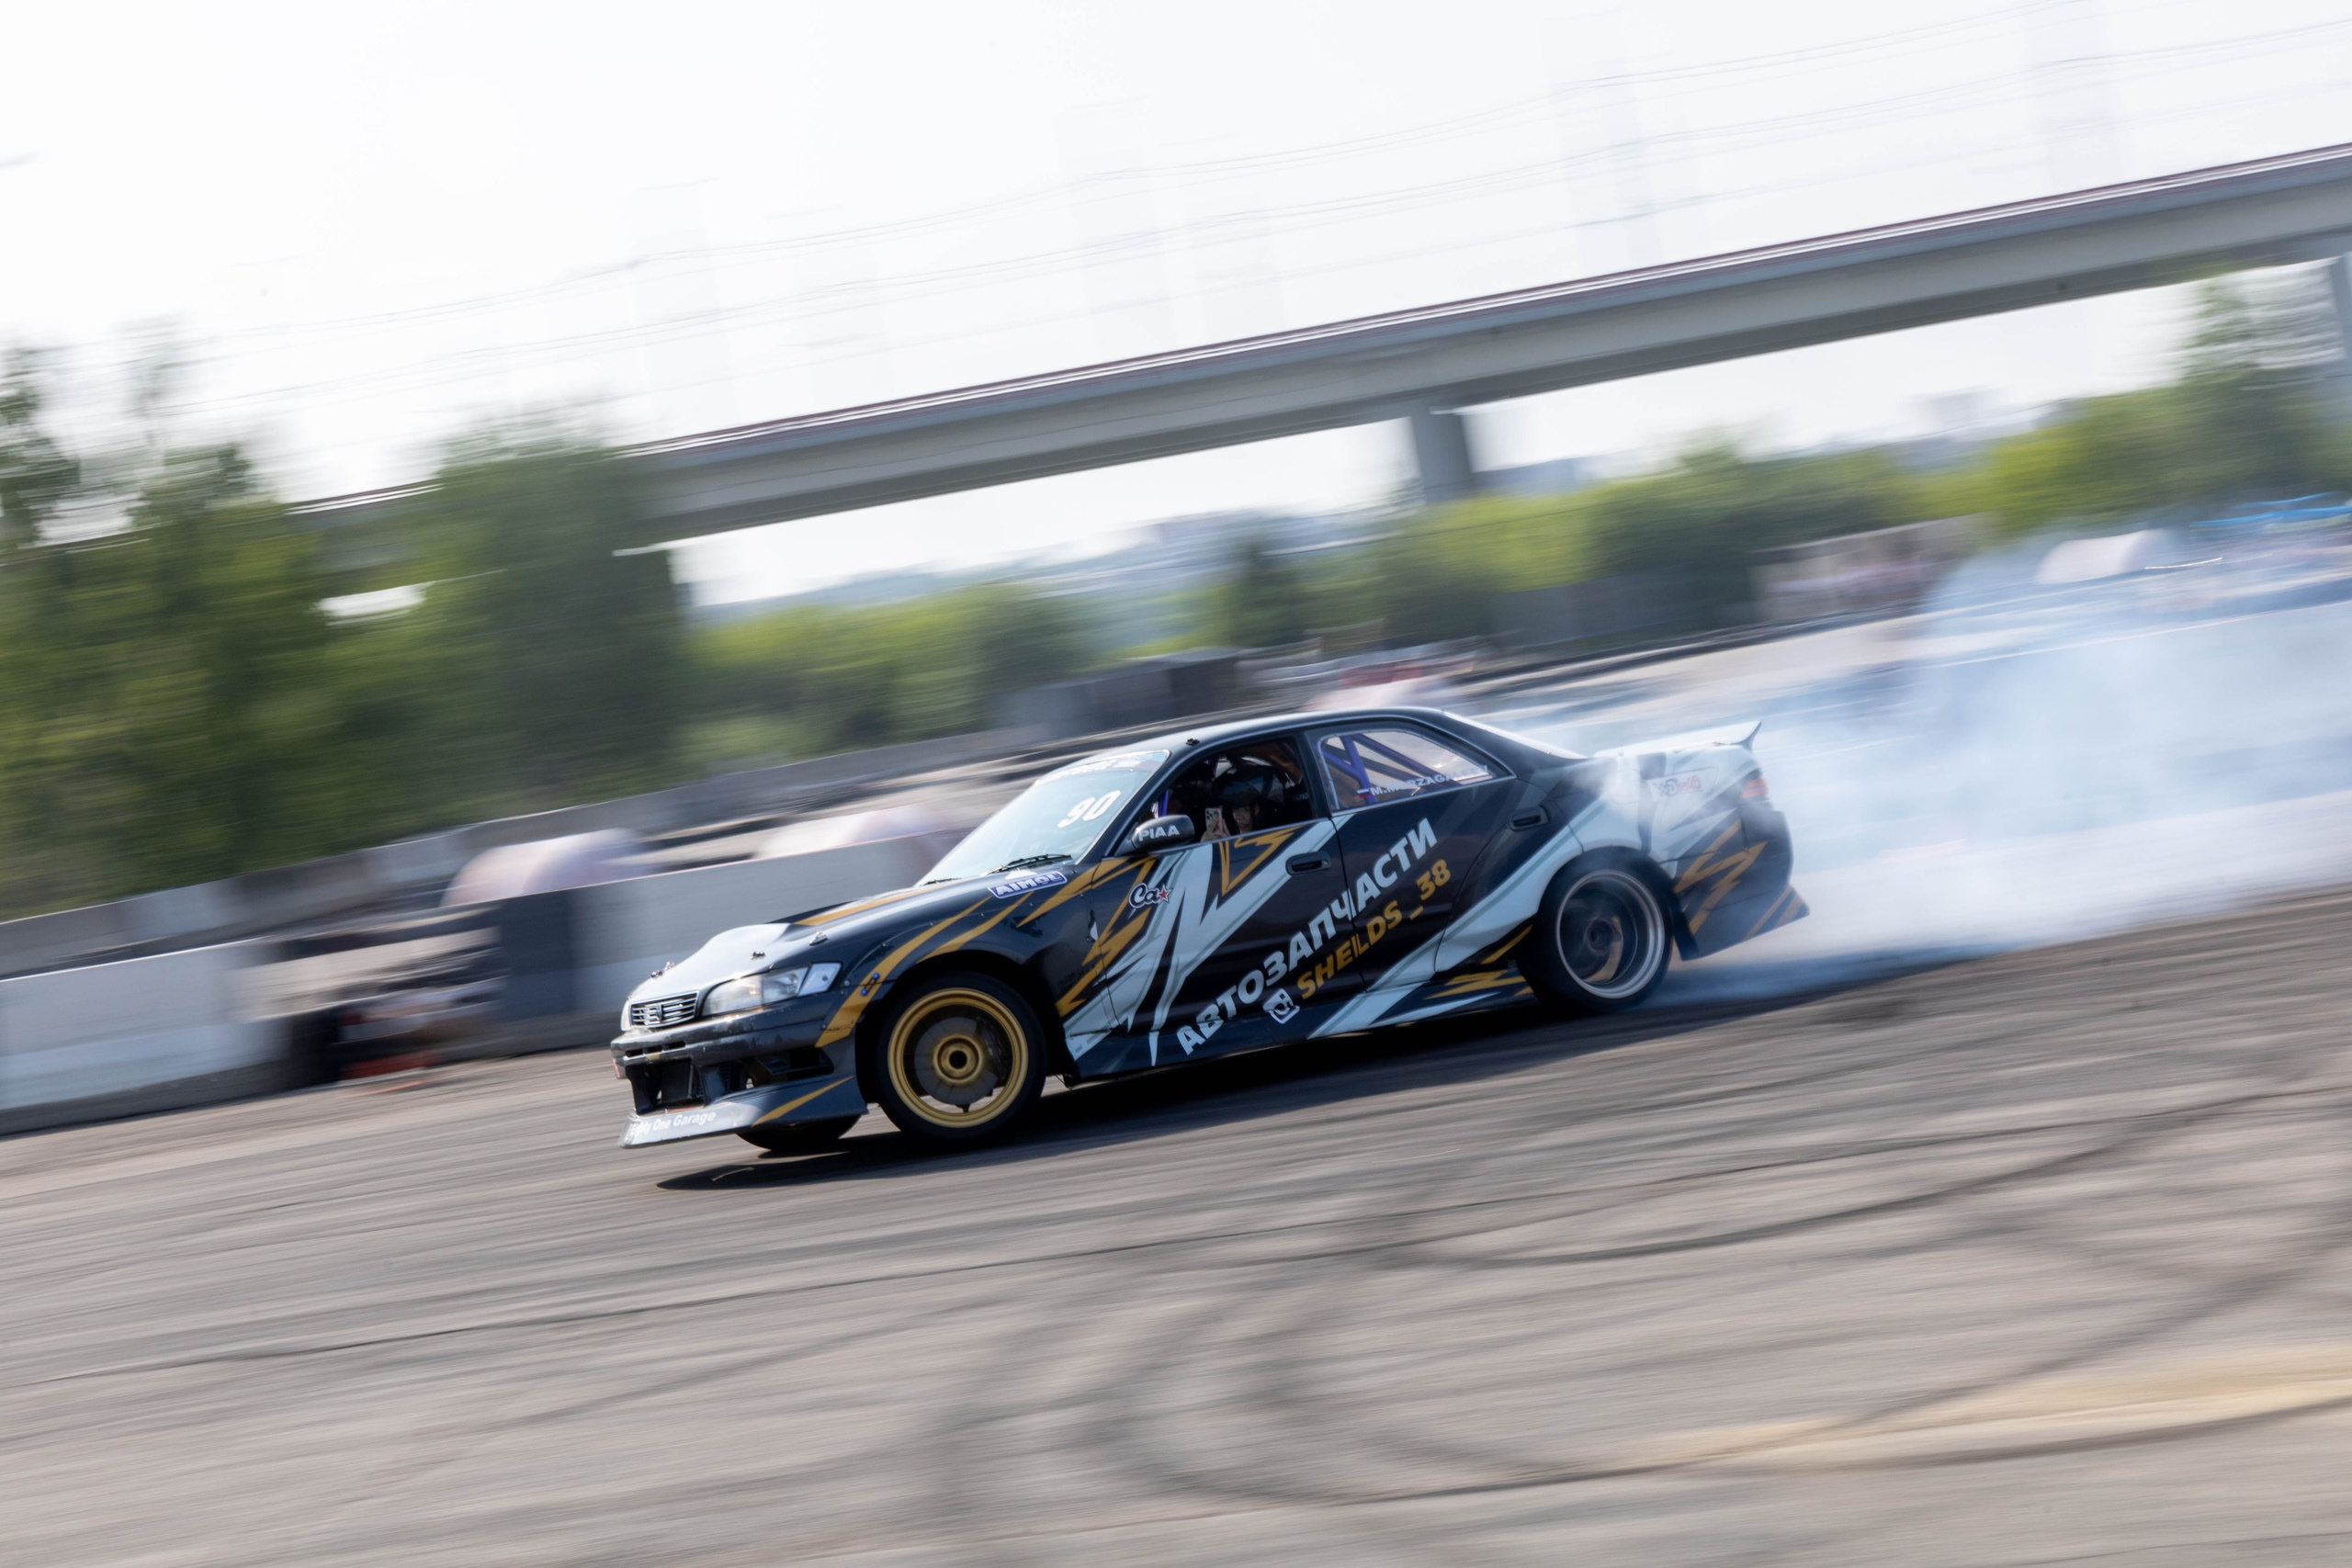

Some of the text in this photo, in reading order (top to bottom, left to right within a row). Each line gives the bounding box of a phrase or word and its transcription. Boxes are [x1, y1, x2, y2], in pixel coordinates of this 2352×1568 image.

[1057, 790, 1121, 828] 90
[1138, 825, 1180, 841] PIAA
[997, 872, 1063, 896] AIMOL
[1177, 818, 1438, 1055] АВТОЗАПЧАСТИ
[673, 1111, 717, 1126] Garage
